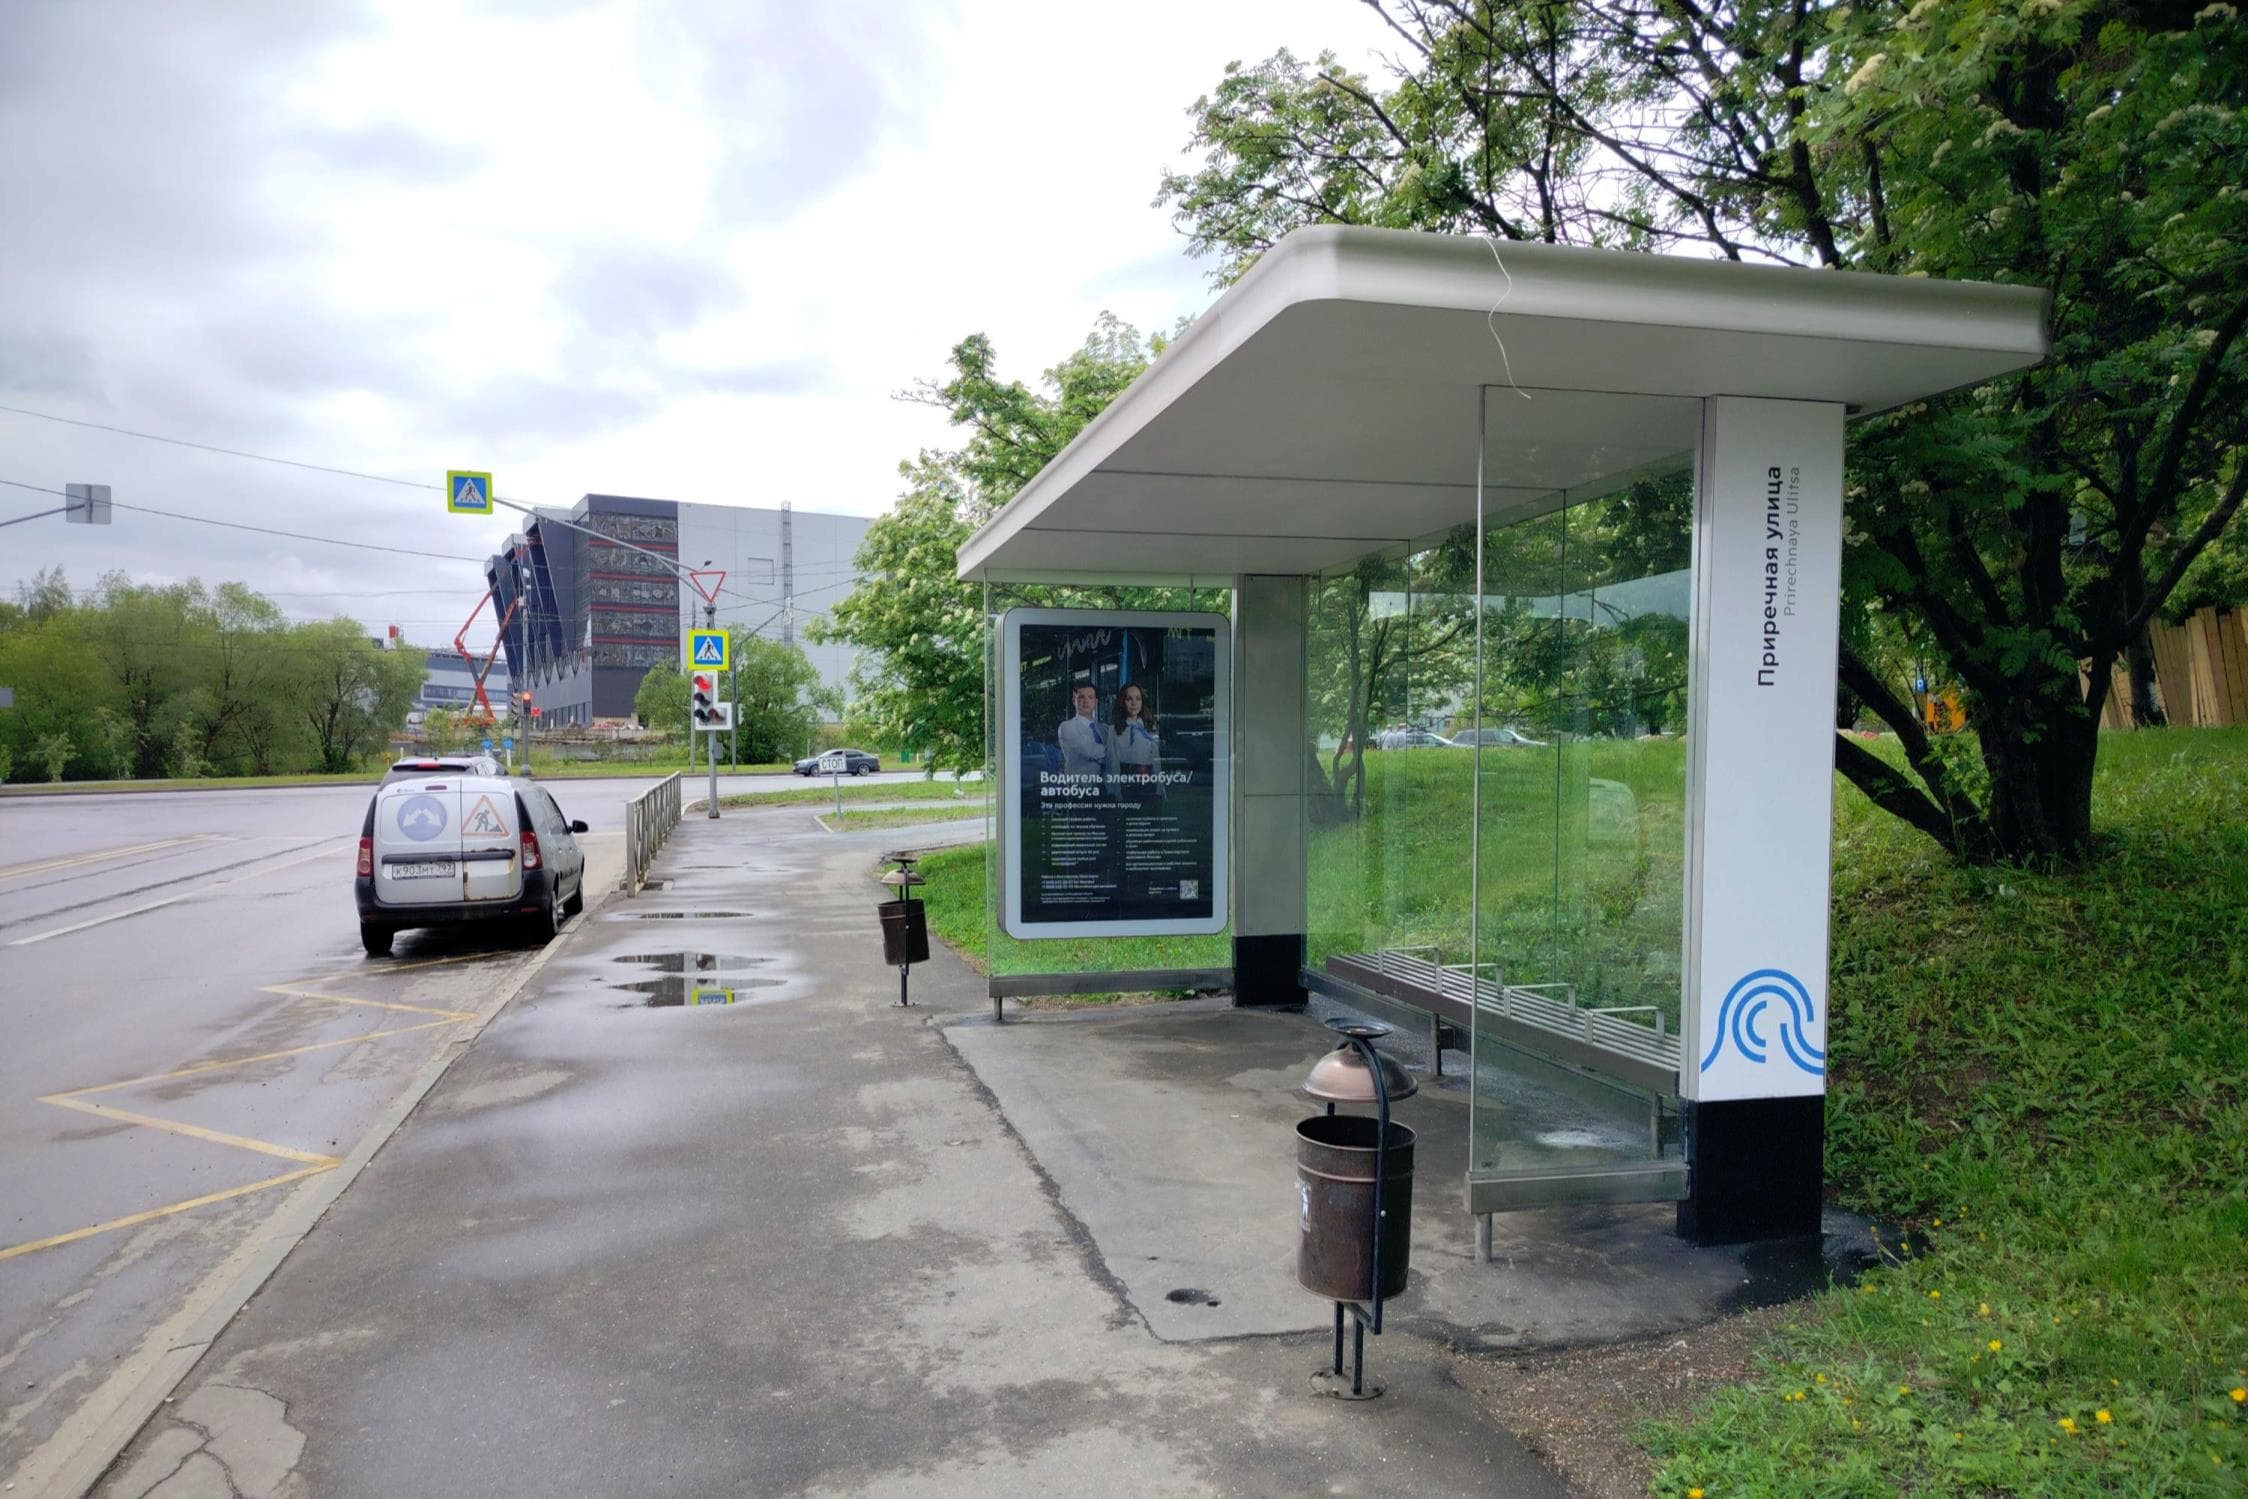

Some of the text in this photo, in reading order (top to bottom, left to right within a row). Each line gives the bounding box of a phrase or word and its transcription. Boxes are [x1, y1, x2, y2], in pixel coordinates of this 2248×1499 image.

[1784, 467, 1800, 616] Prirechnaya Ulitsa
[1758, 466, 1783, 686] Приречная улица
[822, 758, 843, 769] СТОП
[1040, 771, 1193, 785] Водитель электробуса/
[1040, 785, 1100, 798] автобуса
[1054, 802, 1092, 810] профессия
[1117, 802, 1142, 810] городу
